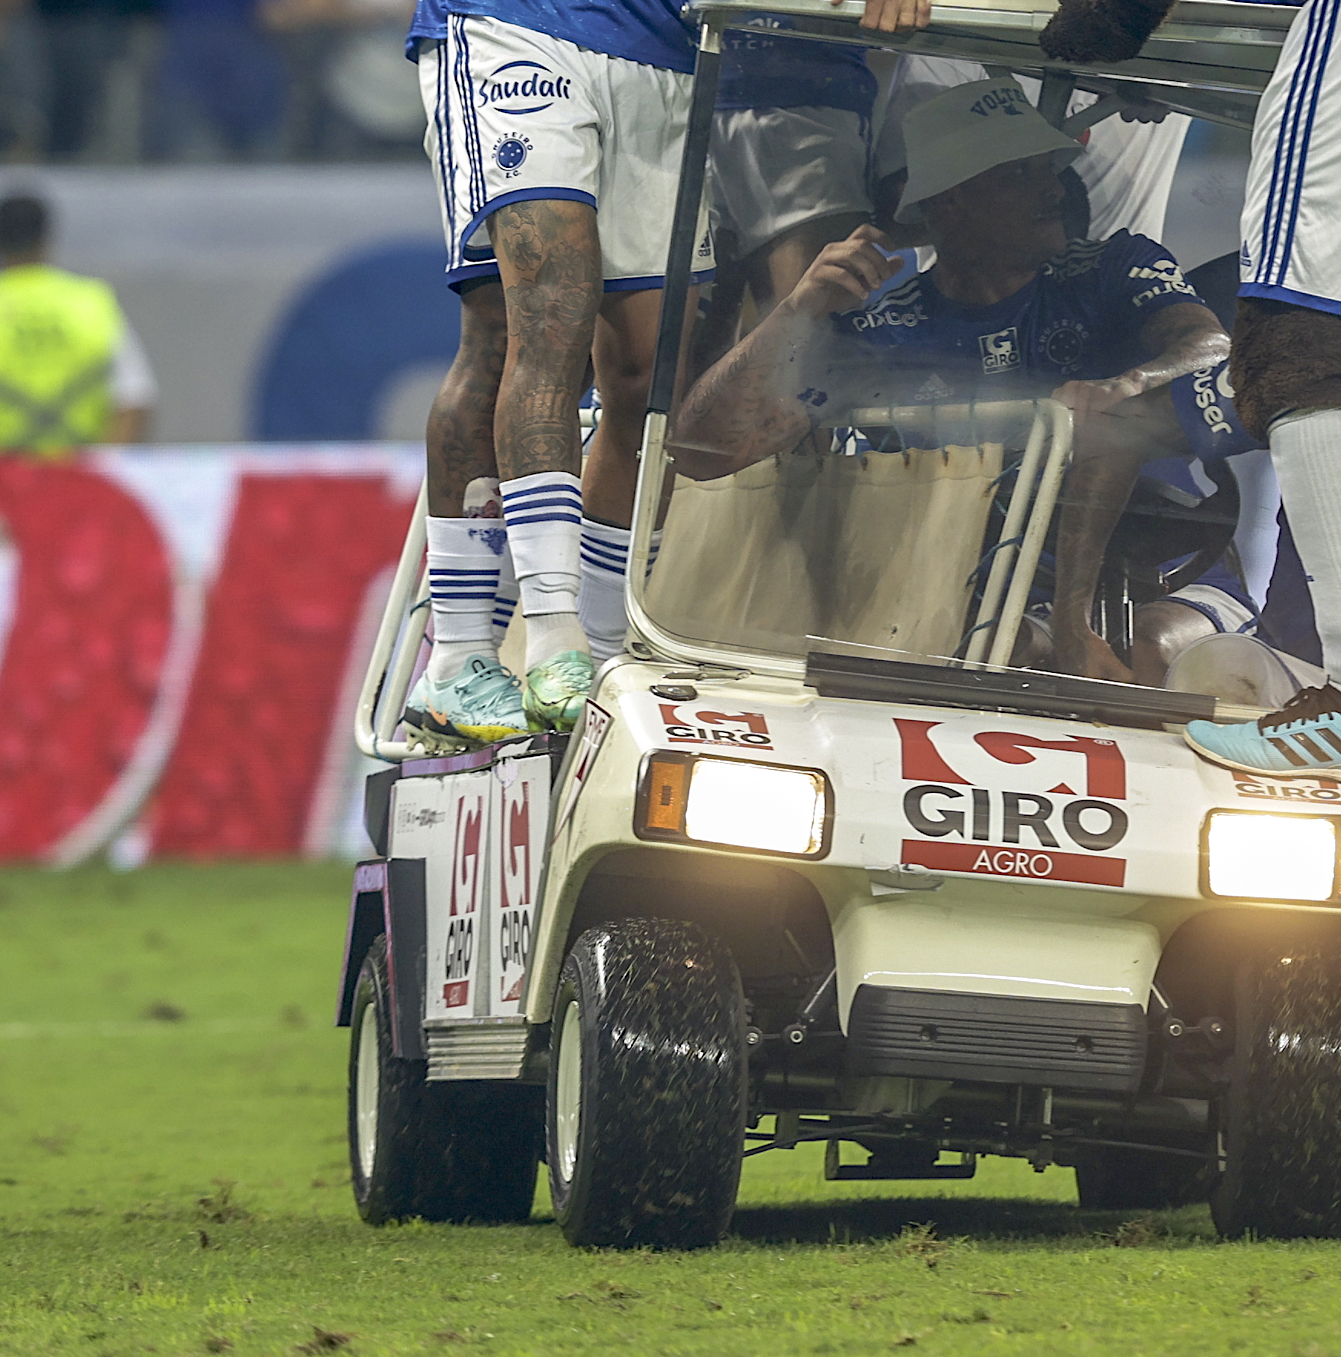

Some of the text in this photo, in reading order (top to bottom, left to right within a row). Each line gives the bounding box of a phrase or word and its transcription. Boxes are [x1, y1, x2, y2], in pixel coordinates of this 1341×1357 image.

[477, 72, 572, 108] Saudali
[984, 352, 1019, 367] GIRO
[666, 726, 771, 744] GIRO
[1235, 783, 1341, 800] GIRO
[902, 784, 1129, 851] GIRO
[972, 849, 1054, 877] AGRO
